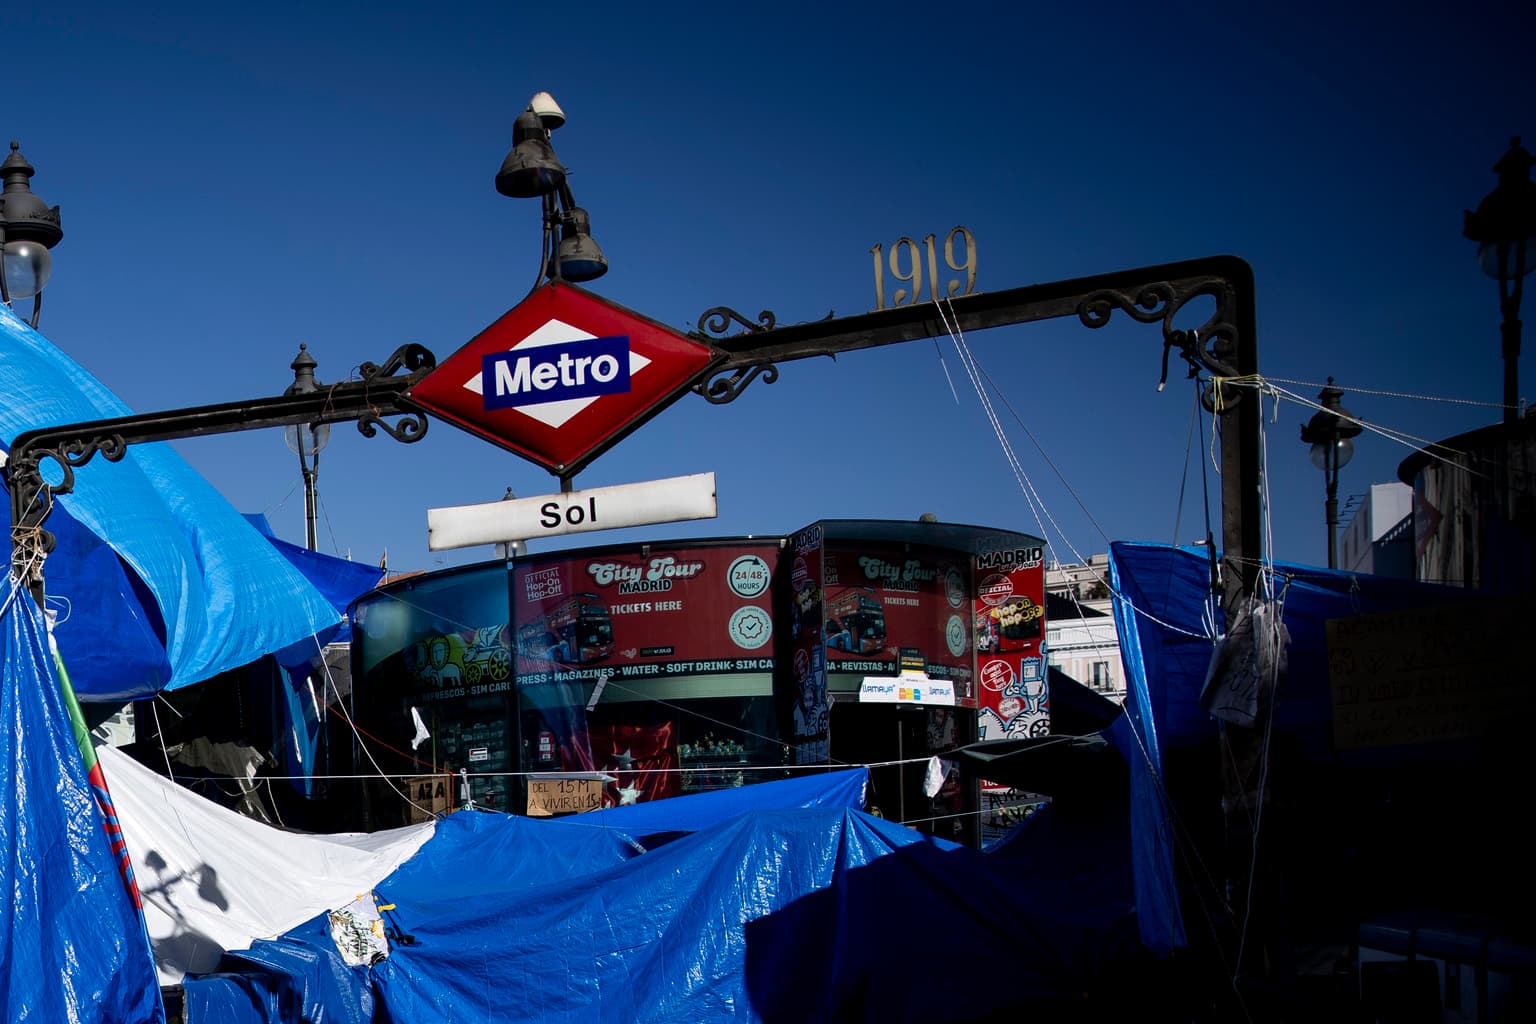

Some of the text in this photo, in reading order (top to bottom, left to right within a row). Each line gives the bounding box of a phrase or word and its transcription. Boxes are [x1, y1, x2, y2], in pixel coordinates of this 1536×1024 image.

[869, 225, 977, 310] 1919
[495, 353, 619, 396] Metro
[539, 497, 598, 529] Sol
[977, 547, 1043, 569] MADRID
[588, 557, 702, 585] City Tour
[619, 579, 672, 594] MADRID
[610, 601, 682, 615] TICKETS HERE
[554, 667, 615, 682] MAGAZINES
[622, 664, 659, 676] WATER
[666, 662, 694, 673] SOFT
[736, 659, 757, 670] SIM
[841, 661, 883, 672] REVISTAS
[471, 684, 488, 695] SIM
[532, 782, 549, 793] DEL
[529, 799, 537, 808] A
[543, 795, 572, 808] VIVIR
